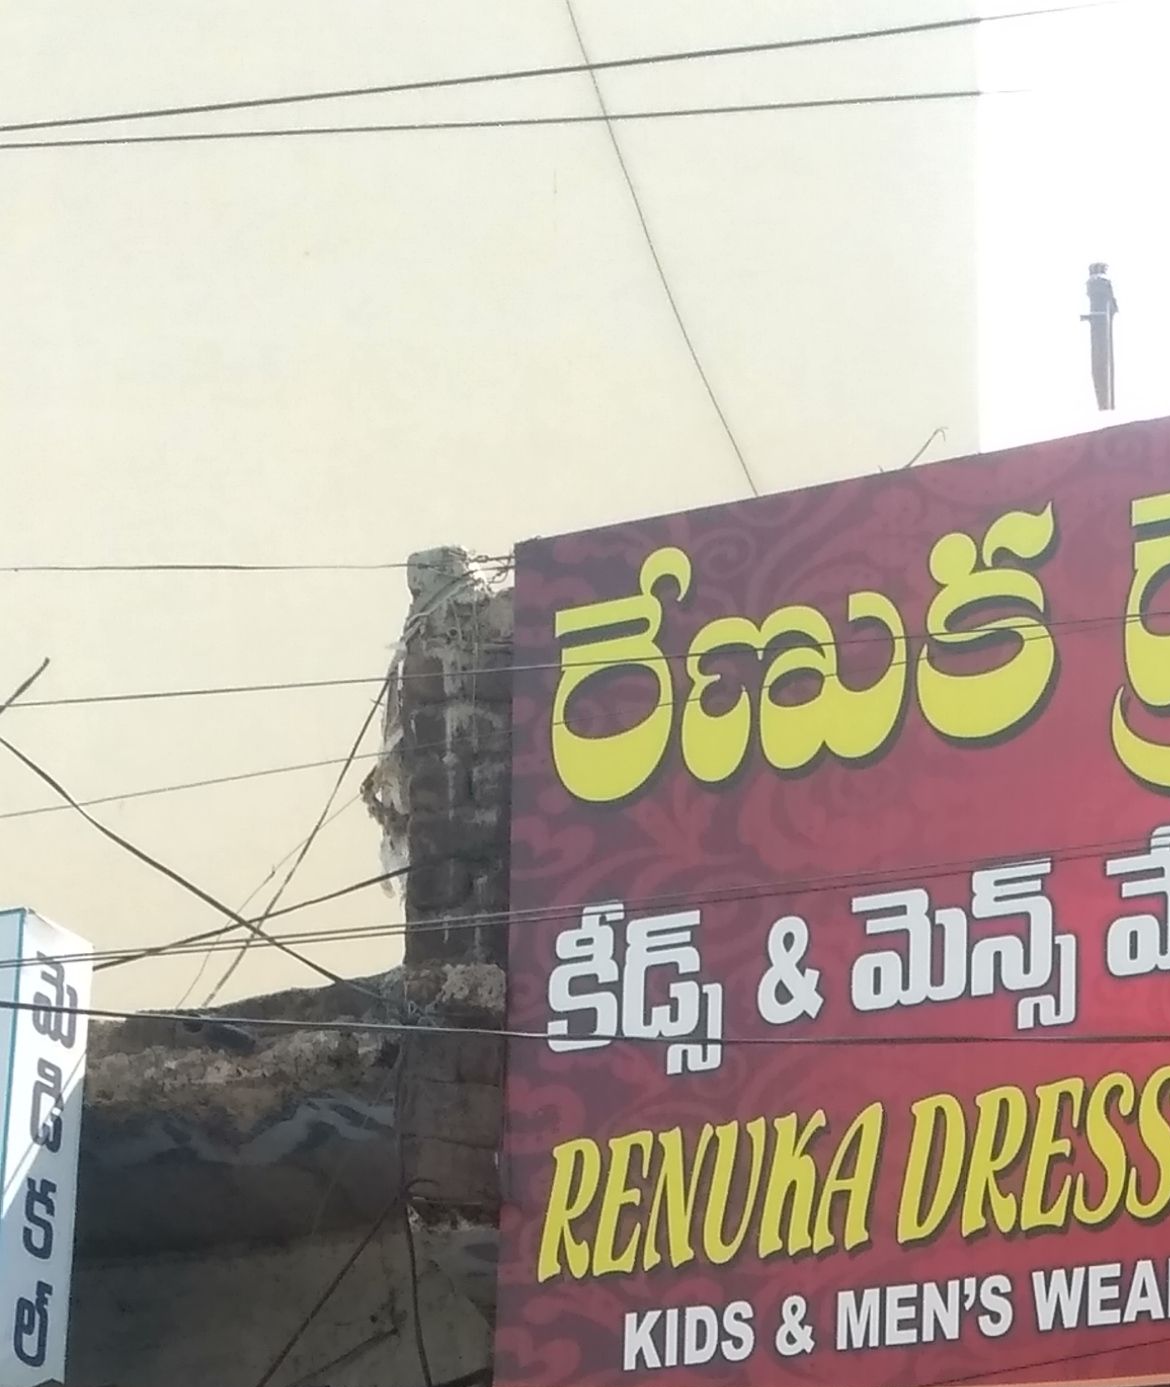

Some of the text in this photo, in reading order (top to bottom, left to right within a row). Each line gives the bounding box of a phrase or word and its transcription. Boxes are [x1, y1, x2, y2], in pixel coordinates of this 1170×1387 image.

[551, 499, 1056, 801] రేణుక
[758, 916, 824, 1024] &
[537, 1102, 884, 1283] RENUKA
[623, 1301, 754, 1370] KIDS
[776, 1295, 815, 1356] &
[836, 1275, 1013, 1350] MEN'S
